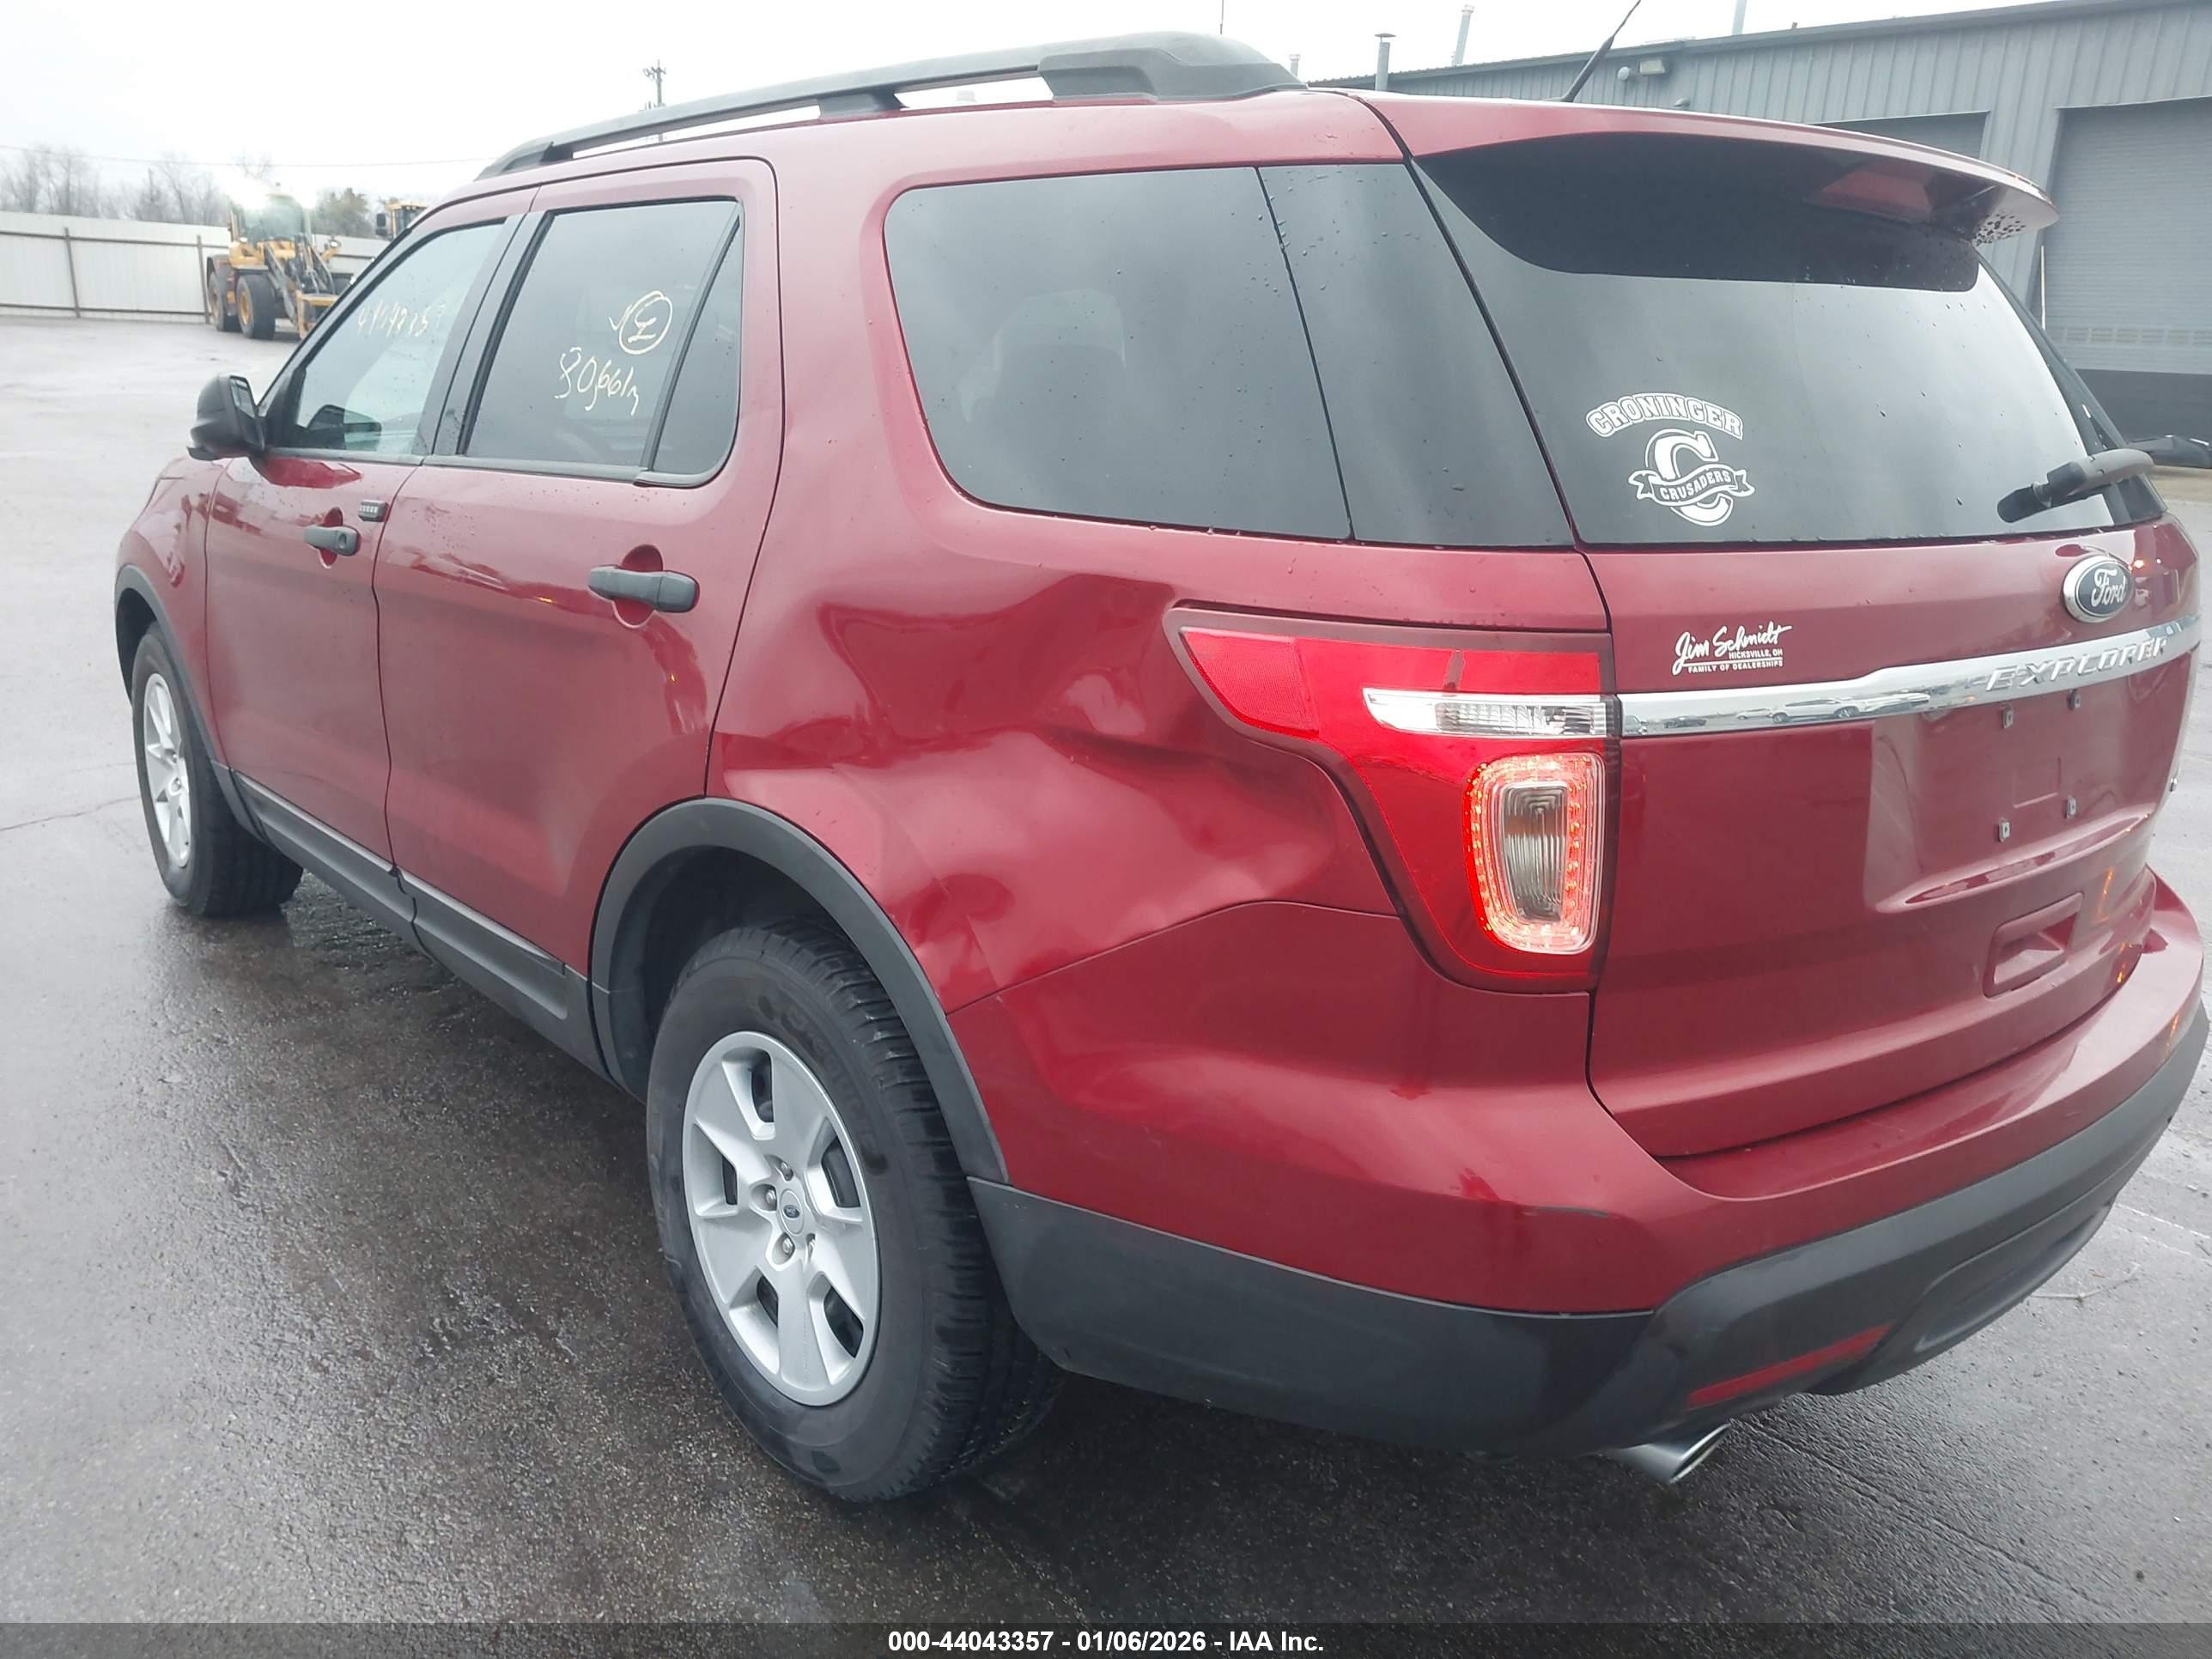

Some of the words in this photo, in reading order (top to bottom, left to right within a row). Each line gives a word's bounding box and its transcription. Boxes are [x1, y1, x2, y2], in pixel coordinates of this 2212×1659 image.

[1586, 392, 1743, 440] CRONINGER
[1660, 470, 1731, 501] CRUSADERS
[2090, 568, 2126, 607] Ford
[1672, 631, 1710, 676] Jim
[1712, 621, 1793, 658] Schmidt
[1687, 665, 1717, 674] FAMILY
[1732, 659, 1784, 671] DEALERSHIPS
[1985, 636, 2167, 691] EXPLORER
